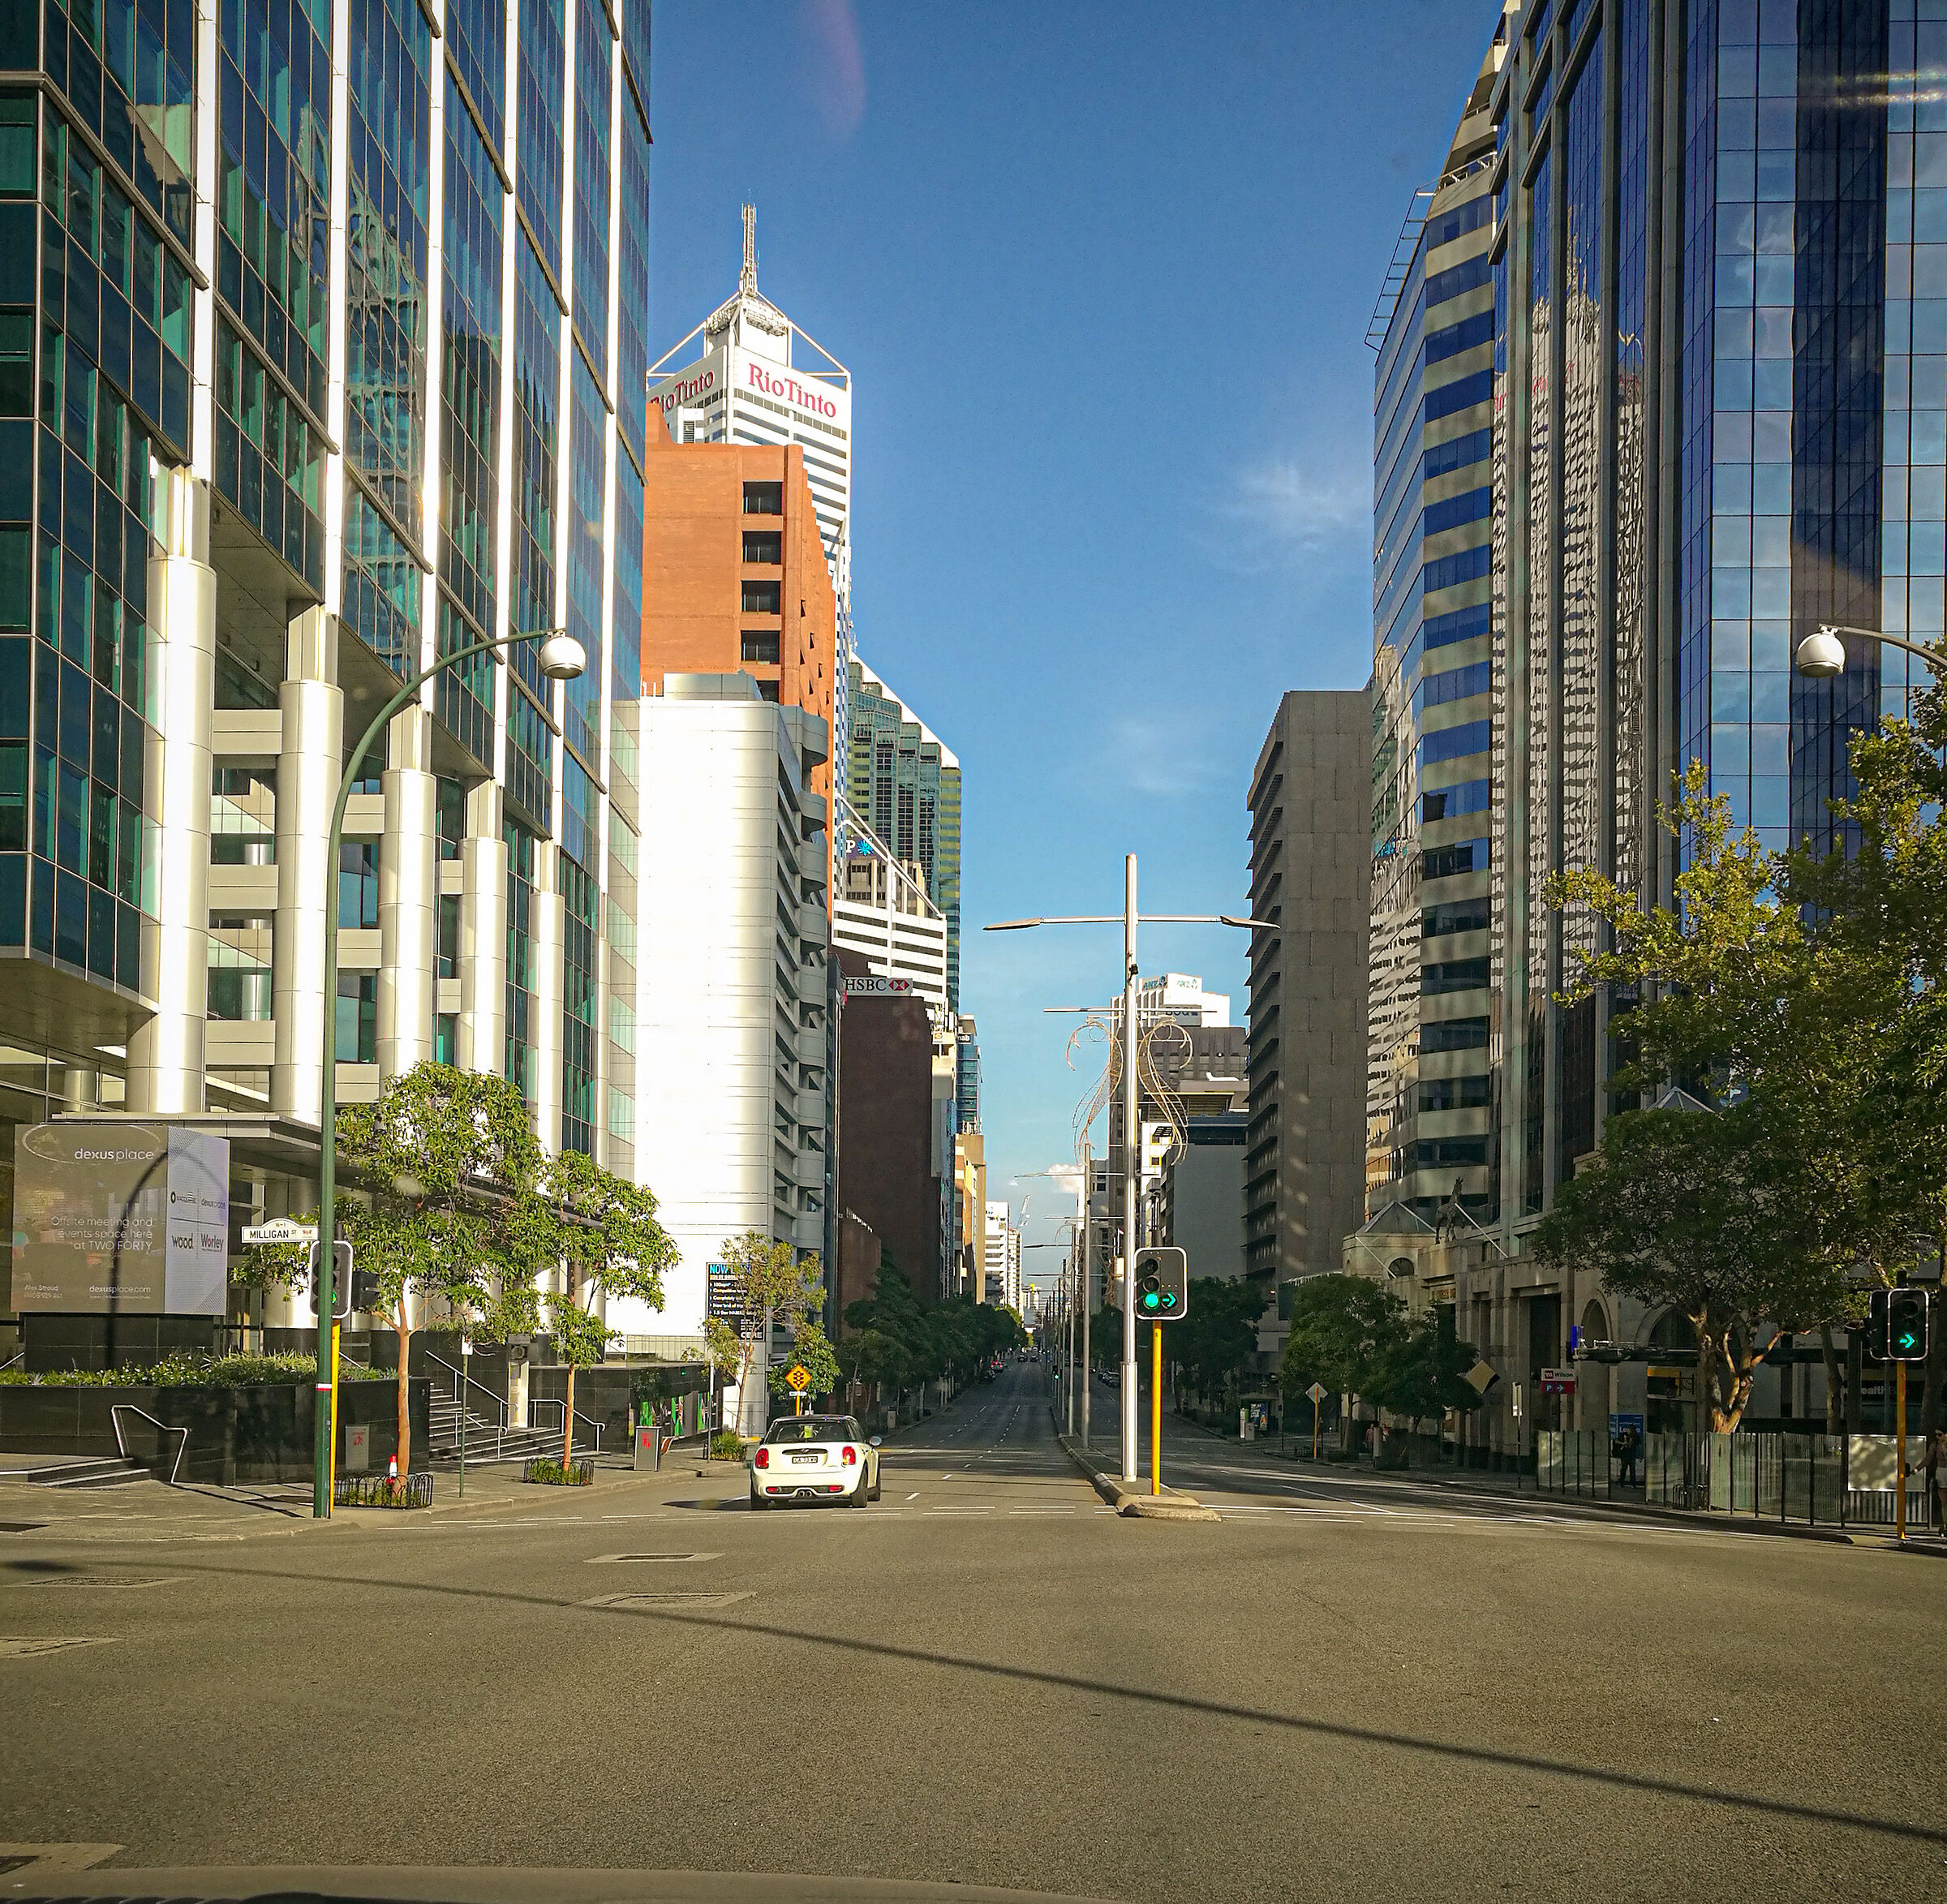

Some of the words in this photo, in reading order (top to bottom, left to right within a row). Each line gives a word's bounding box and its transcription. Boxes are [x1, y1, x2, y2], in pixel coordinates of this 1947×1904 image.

[845, 978, 887, 991] HSBC
[132, 1218, 153, 1227] and
[59, 1229, 92, 1239] events
[94, 1229, 127, 1240] space
[130, 1228, 153, 1239] here
[249, 1229, 289, 1239] MILLIGAN
[74, 1241, 86, 1250] at
[88, 1240, 114, 1250] TWO
[117, 1240, 153, 1251] FORTY
[200, 1233, 224, 1253] Worley
